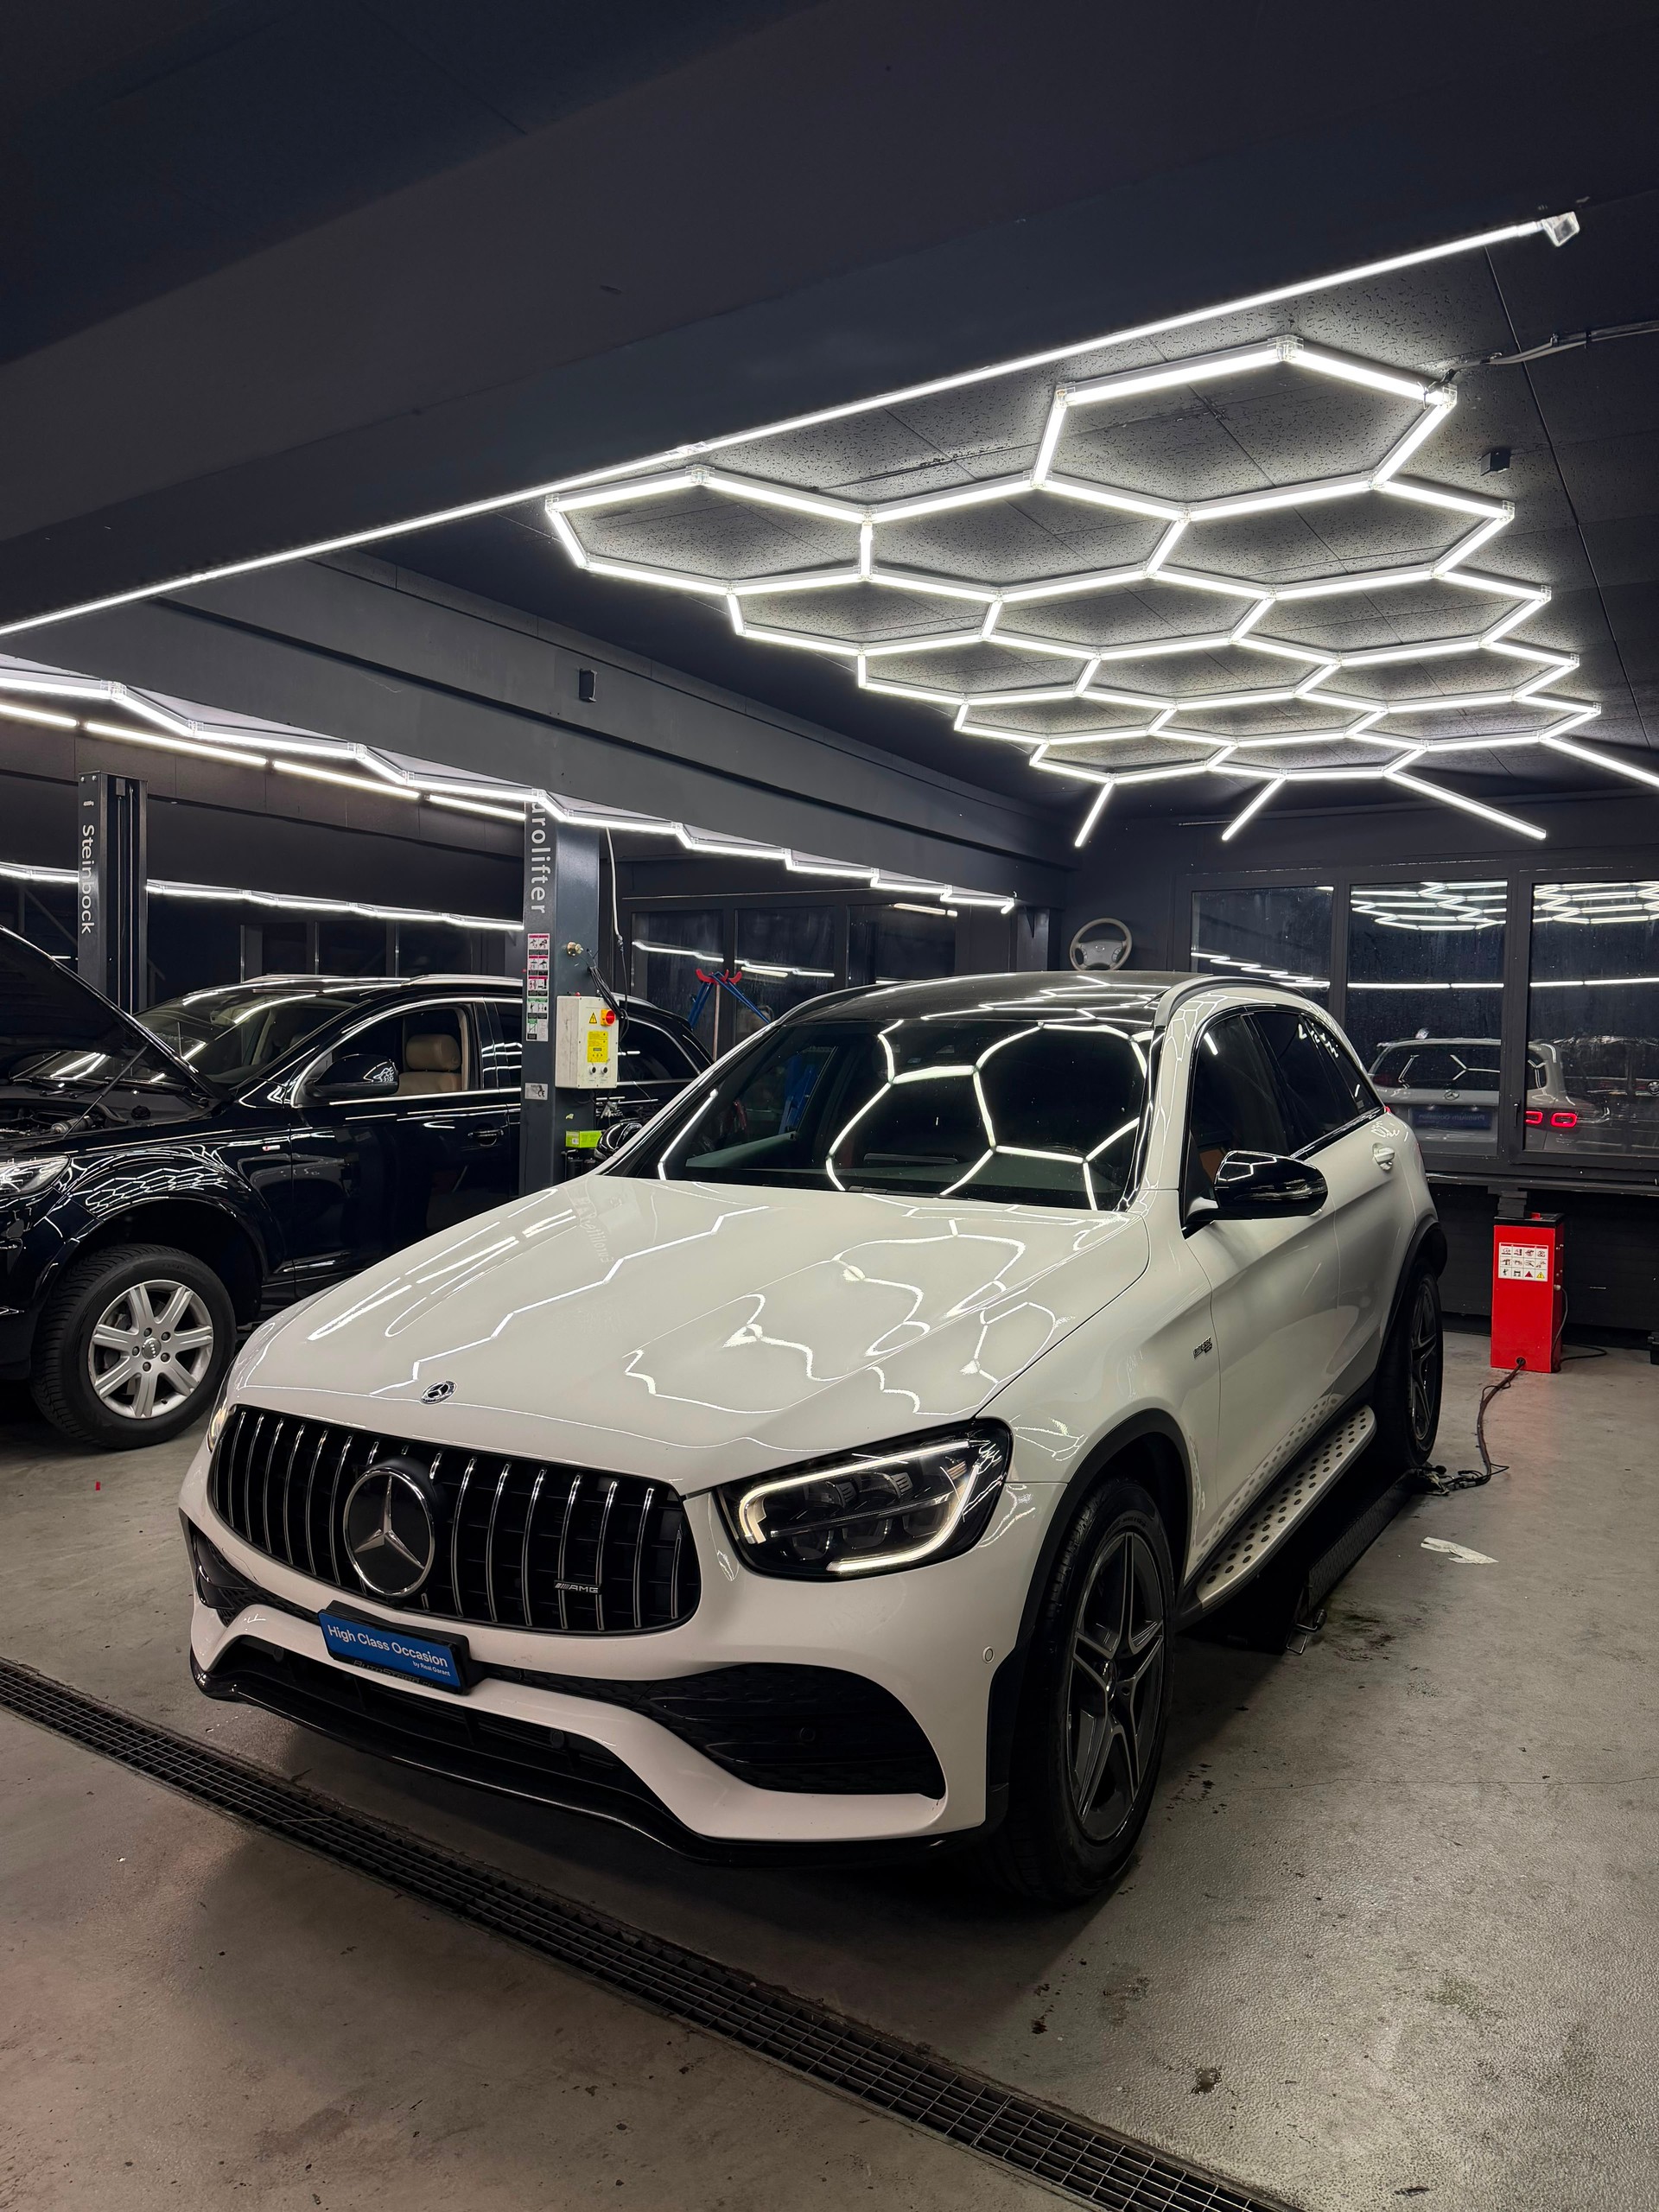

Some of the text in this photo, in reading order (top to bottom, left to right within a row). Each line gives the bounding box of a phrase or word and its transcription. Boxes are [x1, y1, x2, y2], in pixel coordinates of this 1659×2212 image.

[81, 824, 95, 934] Steinbock
[568, 1584, 599, 1594] AMG
[327, 1624, 448, 1668] High Class Occasion
